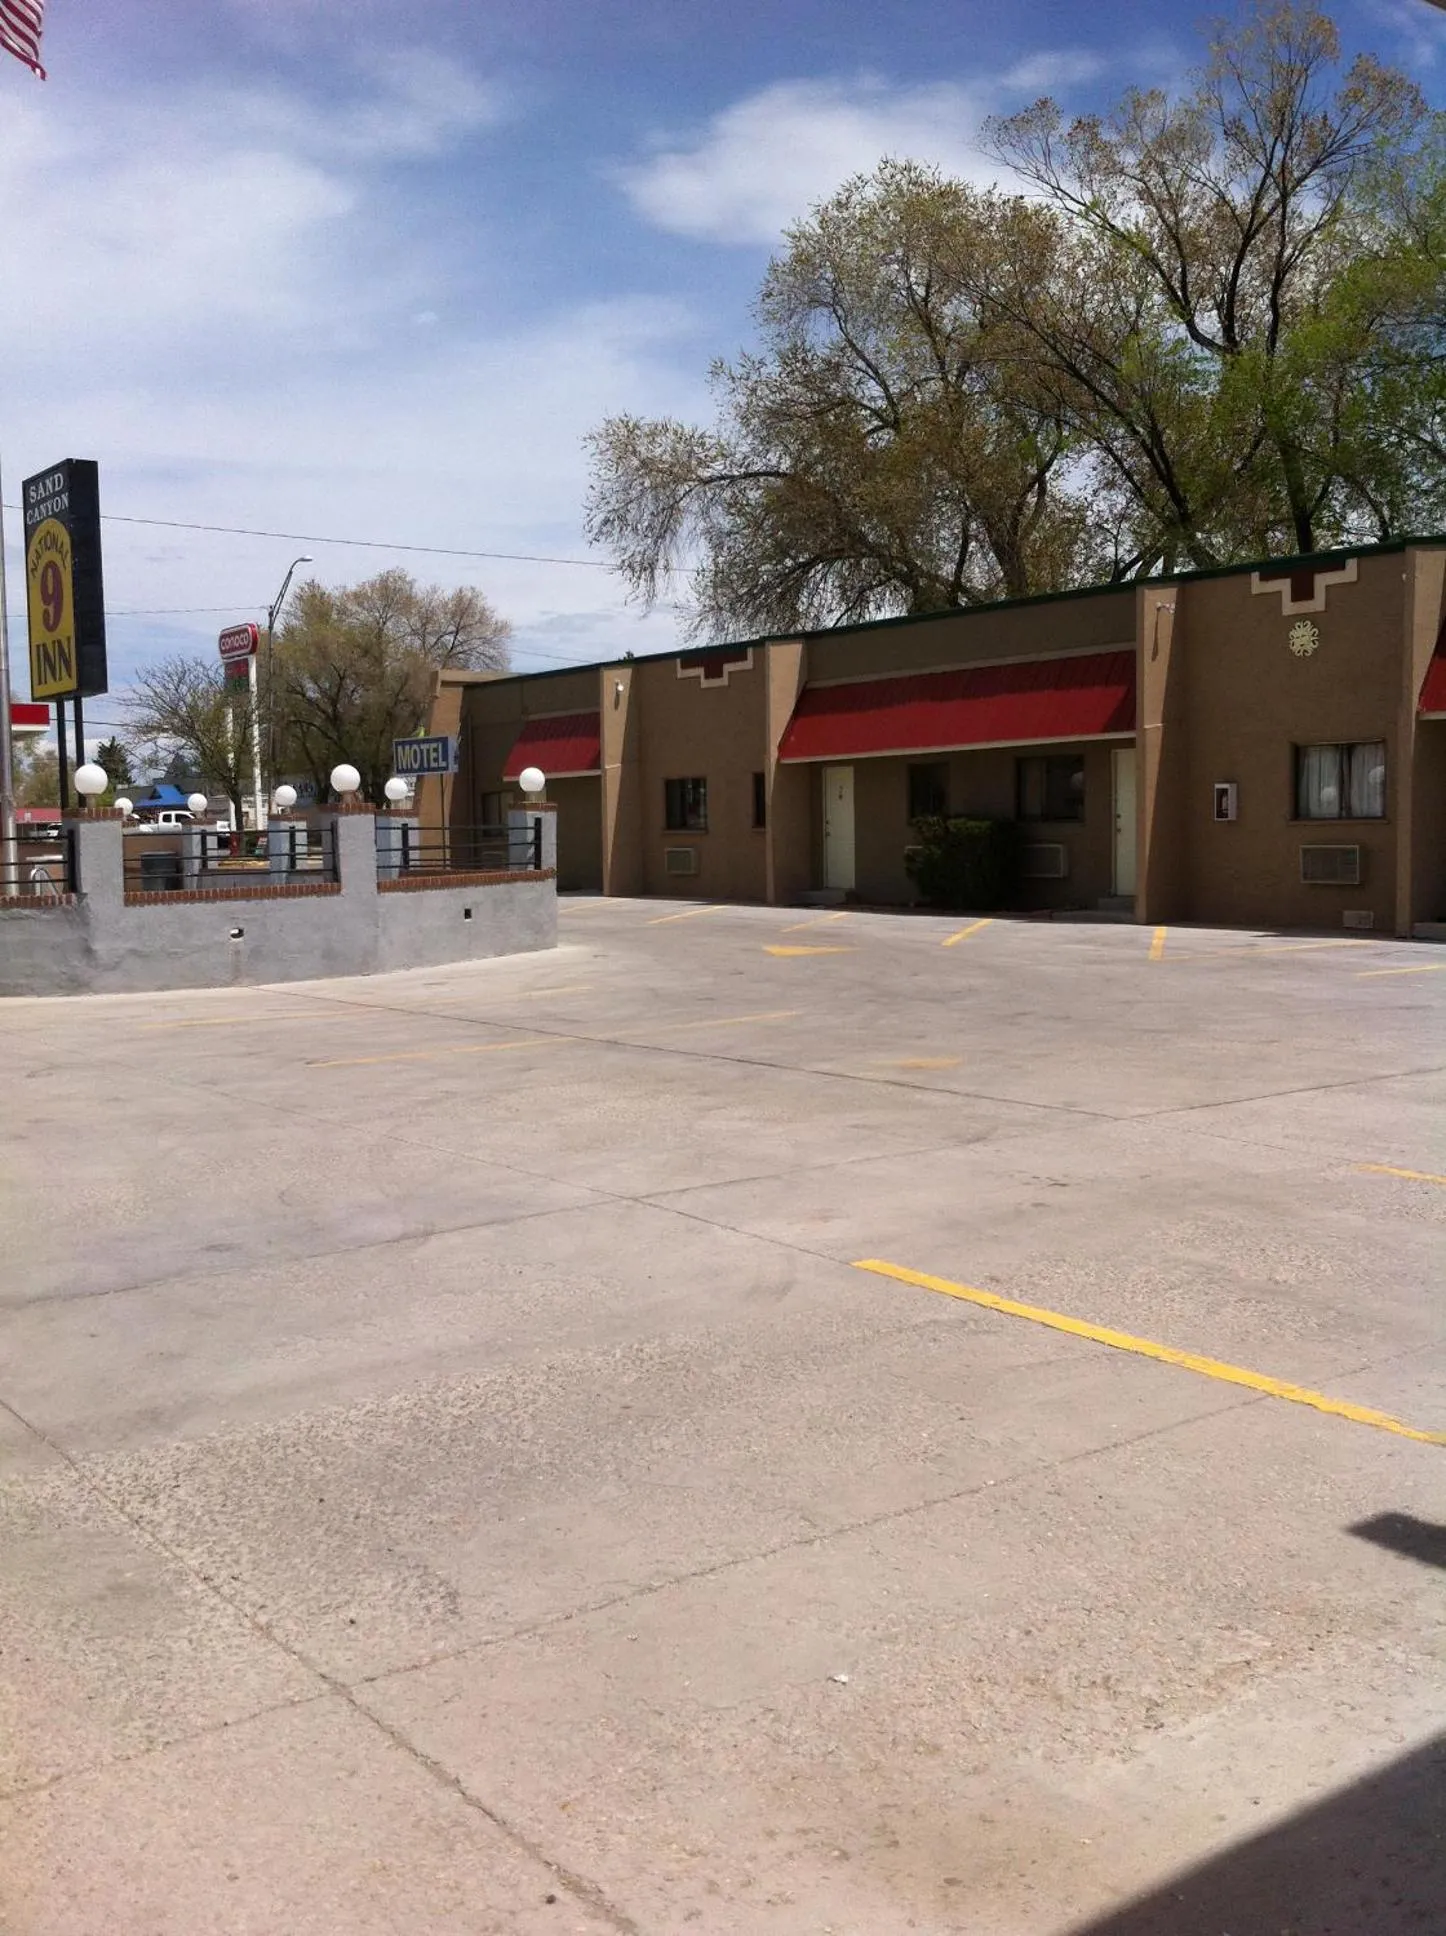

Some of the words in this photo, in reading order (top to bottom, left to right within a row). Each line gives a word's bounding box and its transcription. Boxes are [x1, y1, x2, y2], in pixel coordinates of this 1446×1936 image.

[29, 473, 63, 503] SAND
[26, 493, 69, 525] CANYON
[30, 530, 68, 579] NATIONAL
[40, 561, 63, 632] 9
[35, 637, 72, 686] INN
[397, 742, 446, 770] MOTEL
